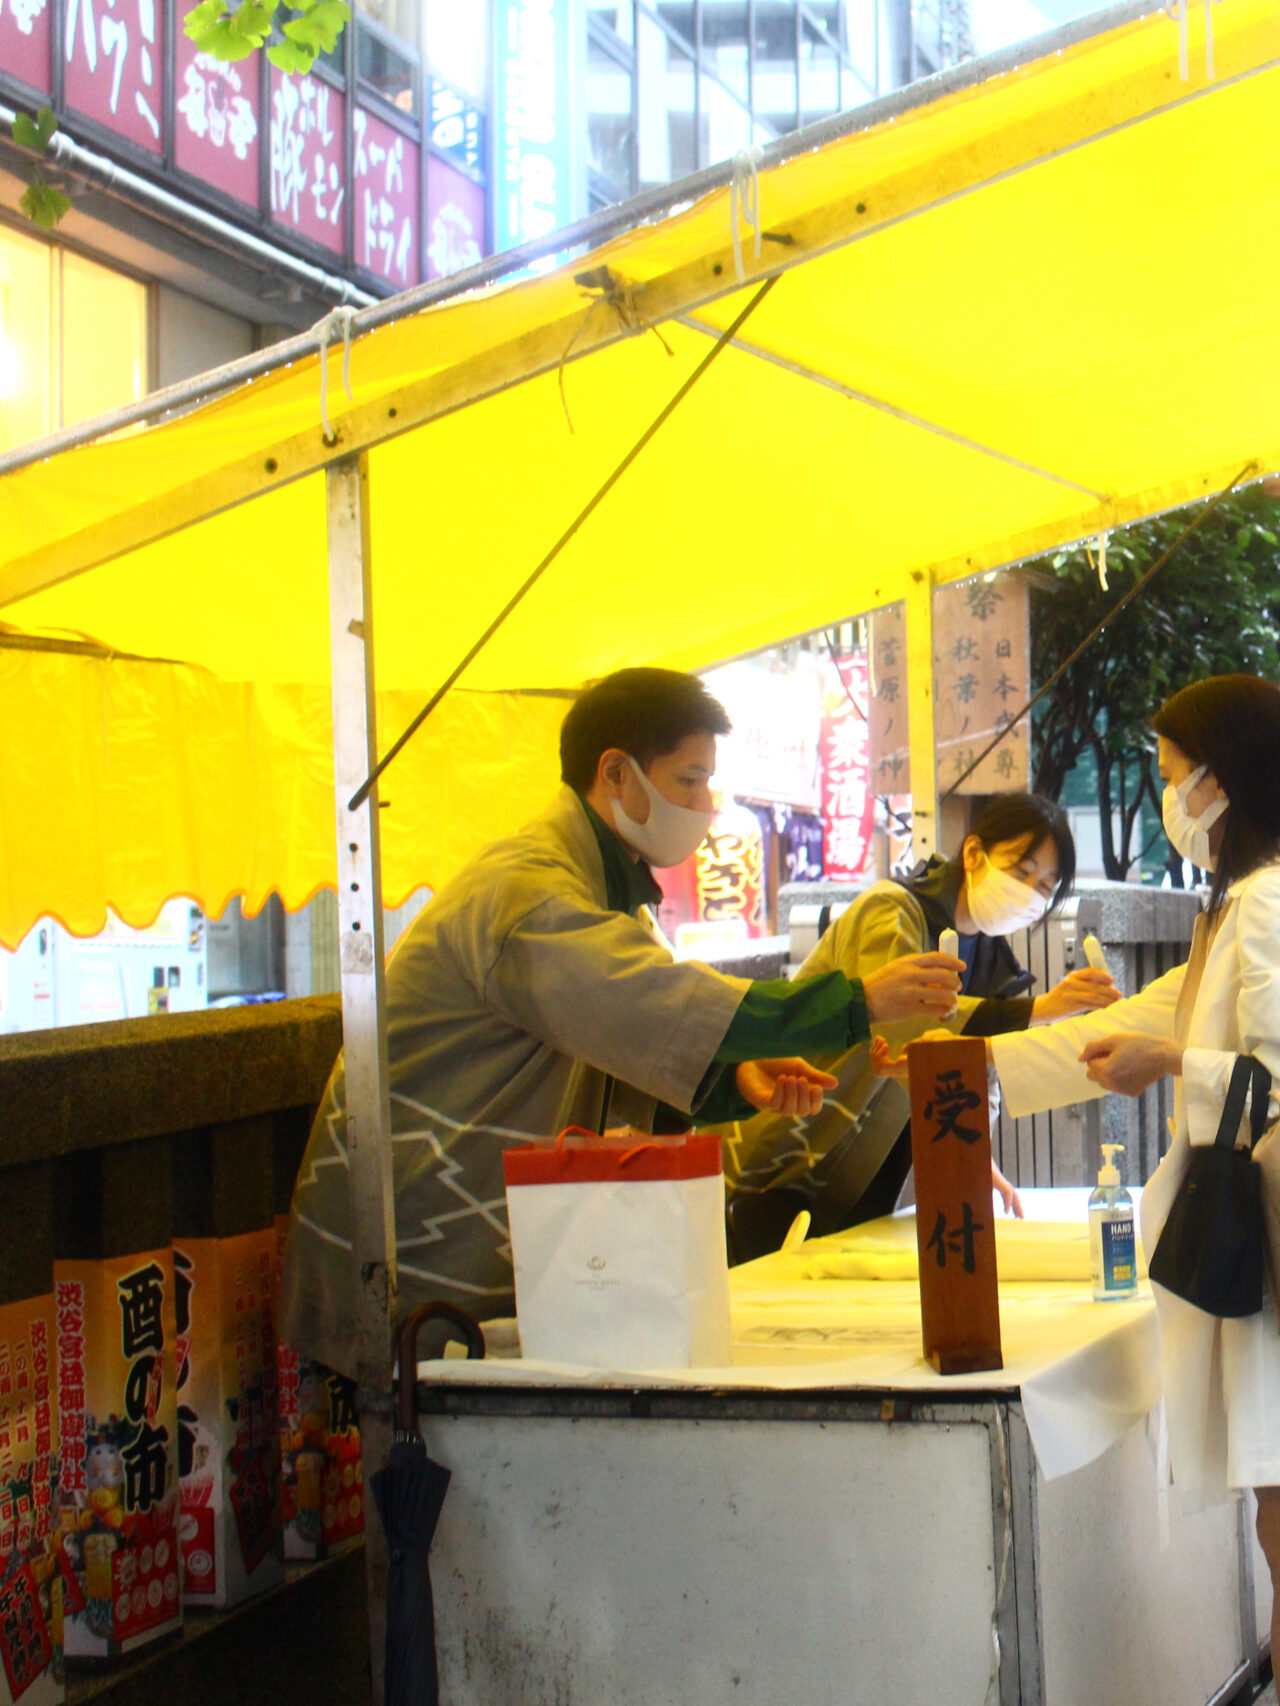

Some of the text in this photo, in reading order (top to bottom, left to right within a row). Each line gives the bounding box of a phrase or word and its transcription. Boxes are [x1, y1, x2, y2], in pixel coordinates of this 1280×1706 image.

[923, 1069, 985, 1275] 受付
[118, 1263, 170, 1513] 酉の市
